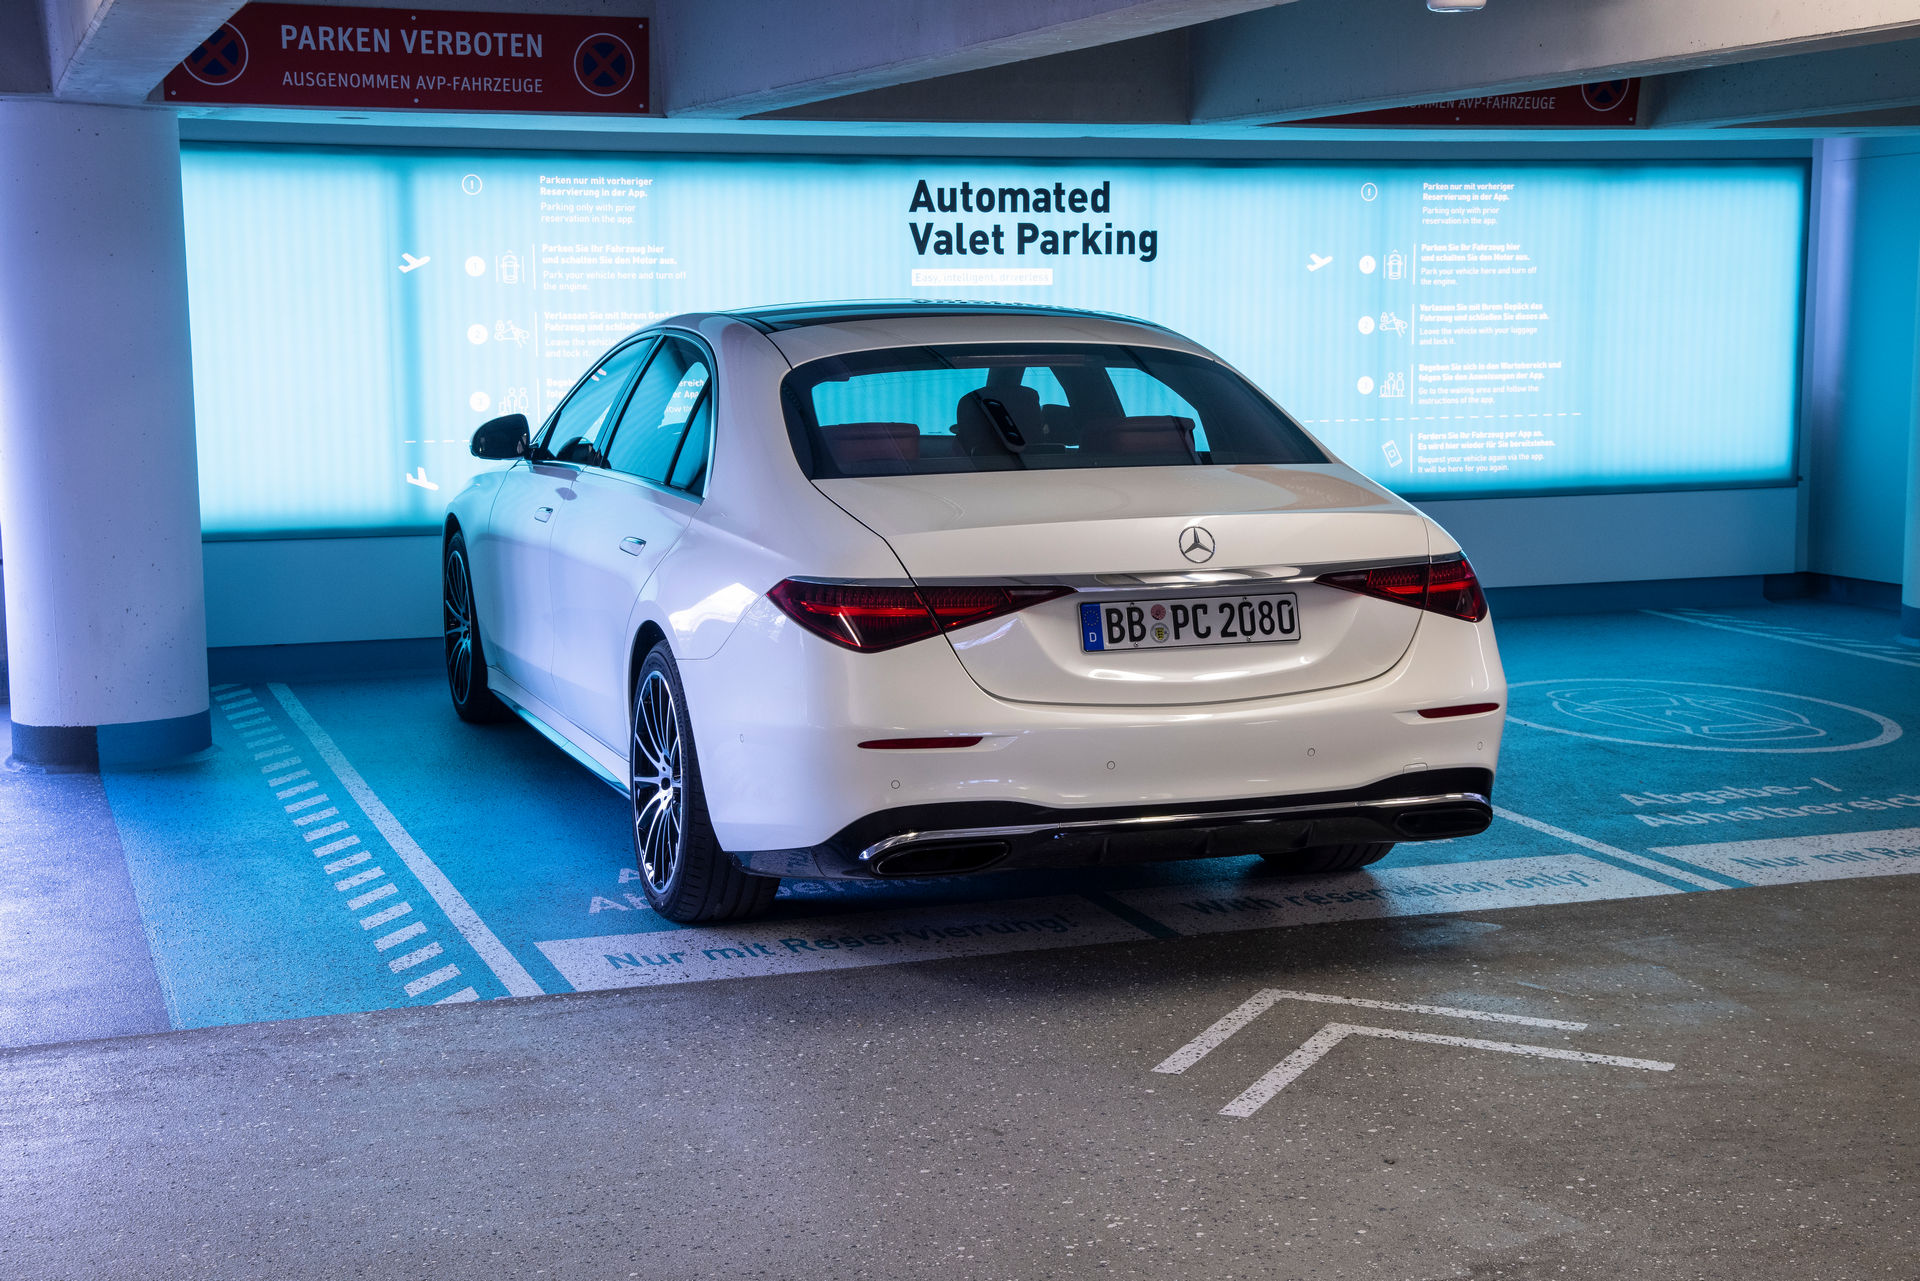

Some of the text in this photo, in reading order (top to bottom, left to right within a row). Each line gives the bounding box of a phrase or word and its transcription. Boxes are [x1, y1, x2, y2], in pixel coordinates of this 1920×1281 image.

[280, 24, 544, 58] PARKEN VERBOTEN
[282, 71, 543, 93] AUSGENOMMEN AVP-FAHRZEUGE
[1458, 96, 1556, 110] AVP-FAHRZEUGE
[539, 176, 571, 184] Parken
[590, 176, 605, 185] mit
[601, 187, 609, 196] in
[611, 187, 626, 196] der
[627, 188, 648, 198] App.
[908, 179, 1110, 213] Automated
[540, 202, 636, 213] Parking only with prior
[591, 215, 599, 223] in
[601, 215, 615, 223] the
[616, 217, 635, 225] app.
[908, 222, 1158, 262] Valet Parking
[915, 272, 941, 284] Easy,
[944, 272, 997, 284] intelligent,
[1105, 600, 1295, 644] BB PC 2080
[1089, 632, 1097, 643] D
[1735, 856, 1807, 870] Nur
[1284, 880, 1501, 907] reservation
[1505, 870, 1601, 888] only!
[604, 914, 1080, 970] Nur mit Reservierung!
